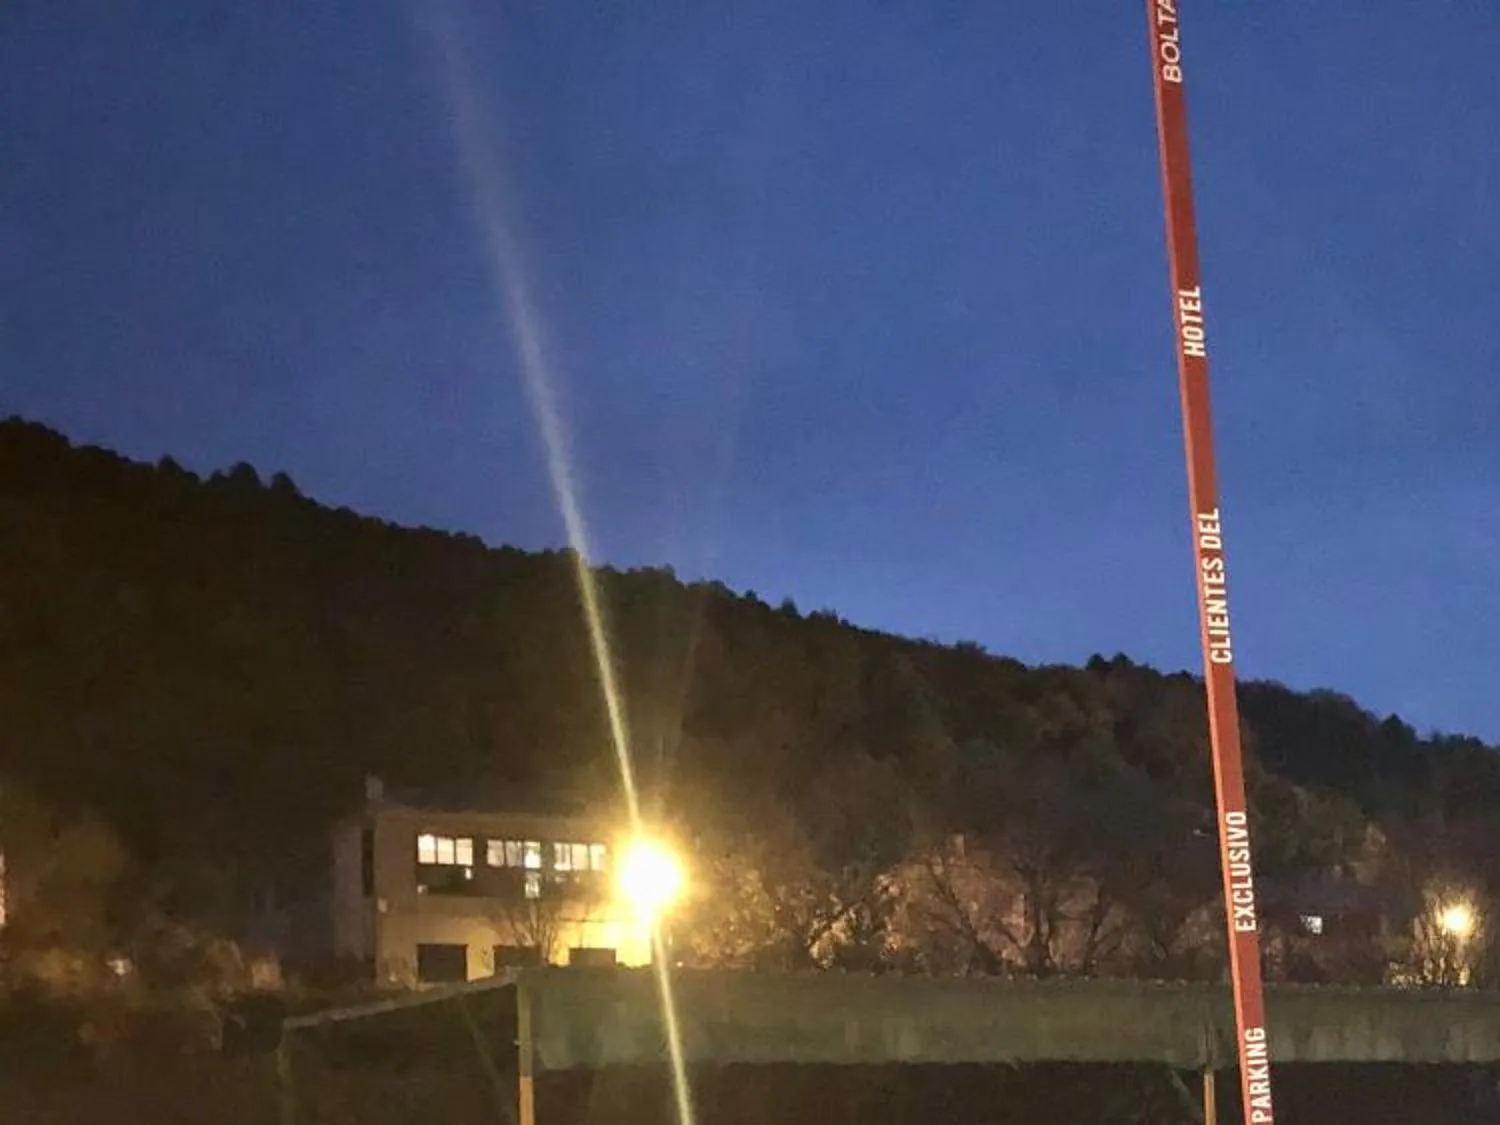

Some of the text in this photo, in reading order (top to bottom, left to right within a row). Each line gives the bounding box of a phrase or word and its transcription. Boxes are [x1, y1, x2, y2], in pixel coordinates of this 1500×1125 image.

[1178, 286, 1206, 359] HOTEL
[1198, 507, 1222, 550] DEL
[1199, 557, 1233, 665] CLIENTES
[1224, 809, 1257, 933] EXCLUSIVO
[1245, 1026, 1273, 1124] PARKING
